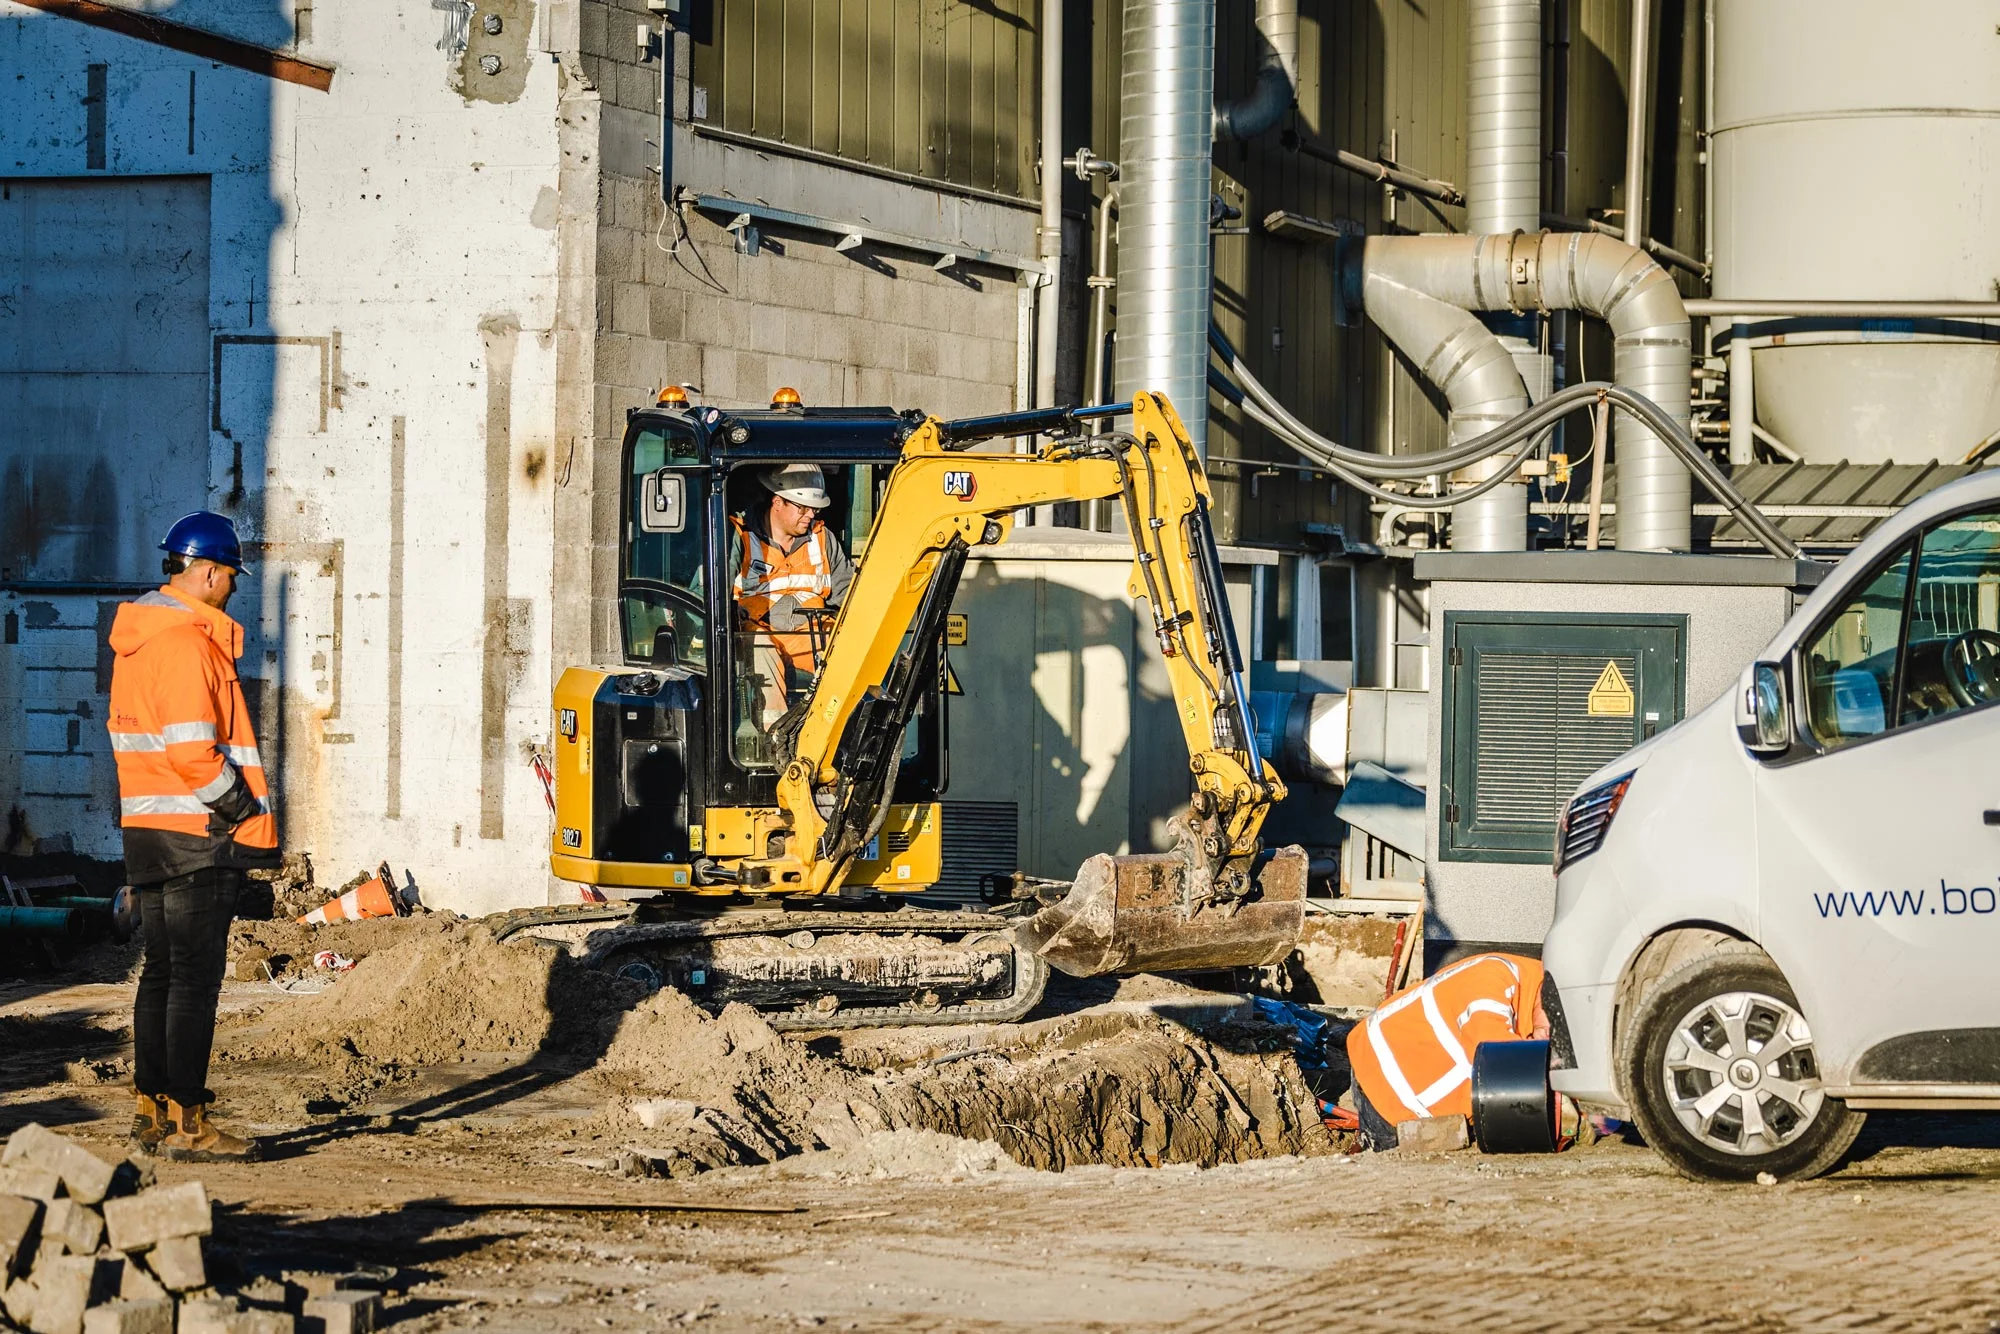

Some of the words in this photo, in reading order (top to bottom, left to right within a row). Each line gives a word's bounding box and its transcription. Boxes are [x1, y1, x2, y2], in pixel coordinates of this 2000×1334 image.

[944, 472, 970, 495] CAT
[560, 709, 575, 735] CAT
[562, 827, 580, 847] 302.7
